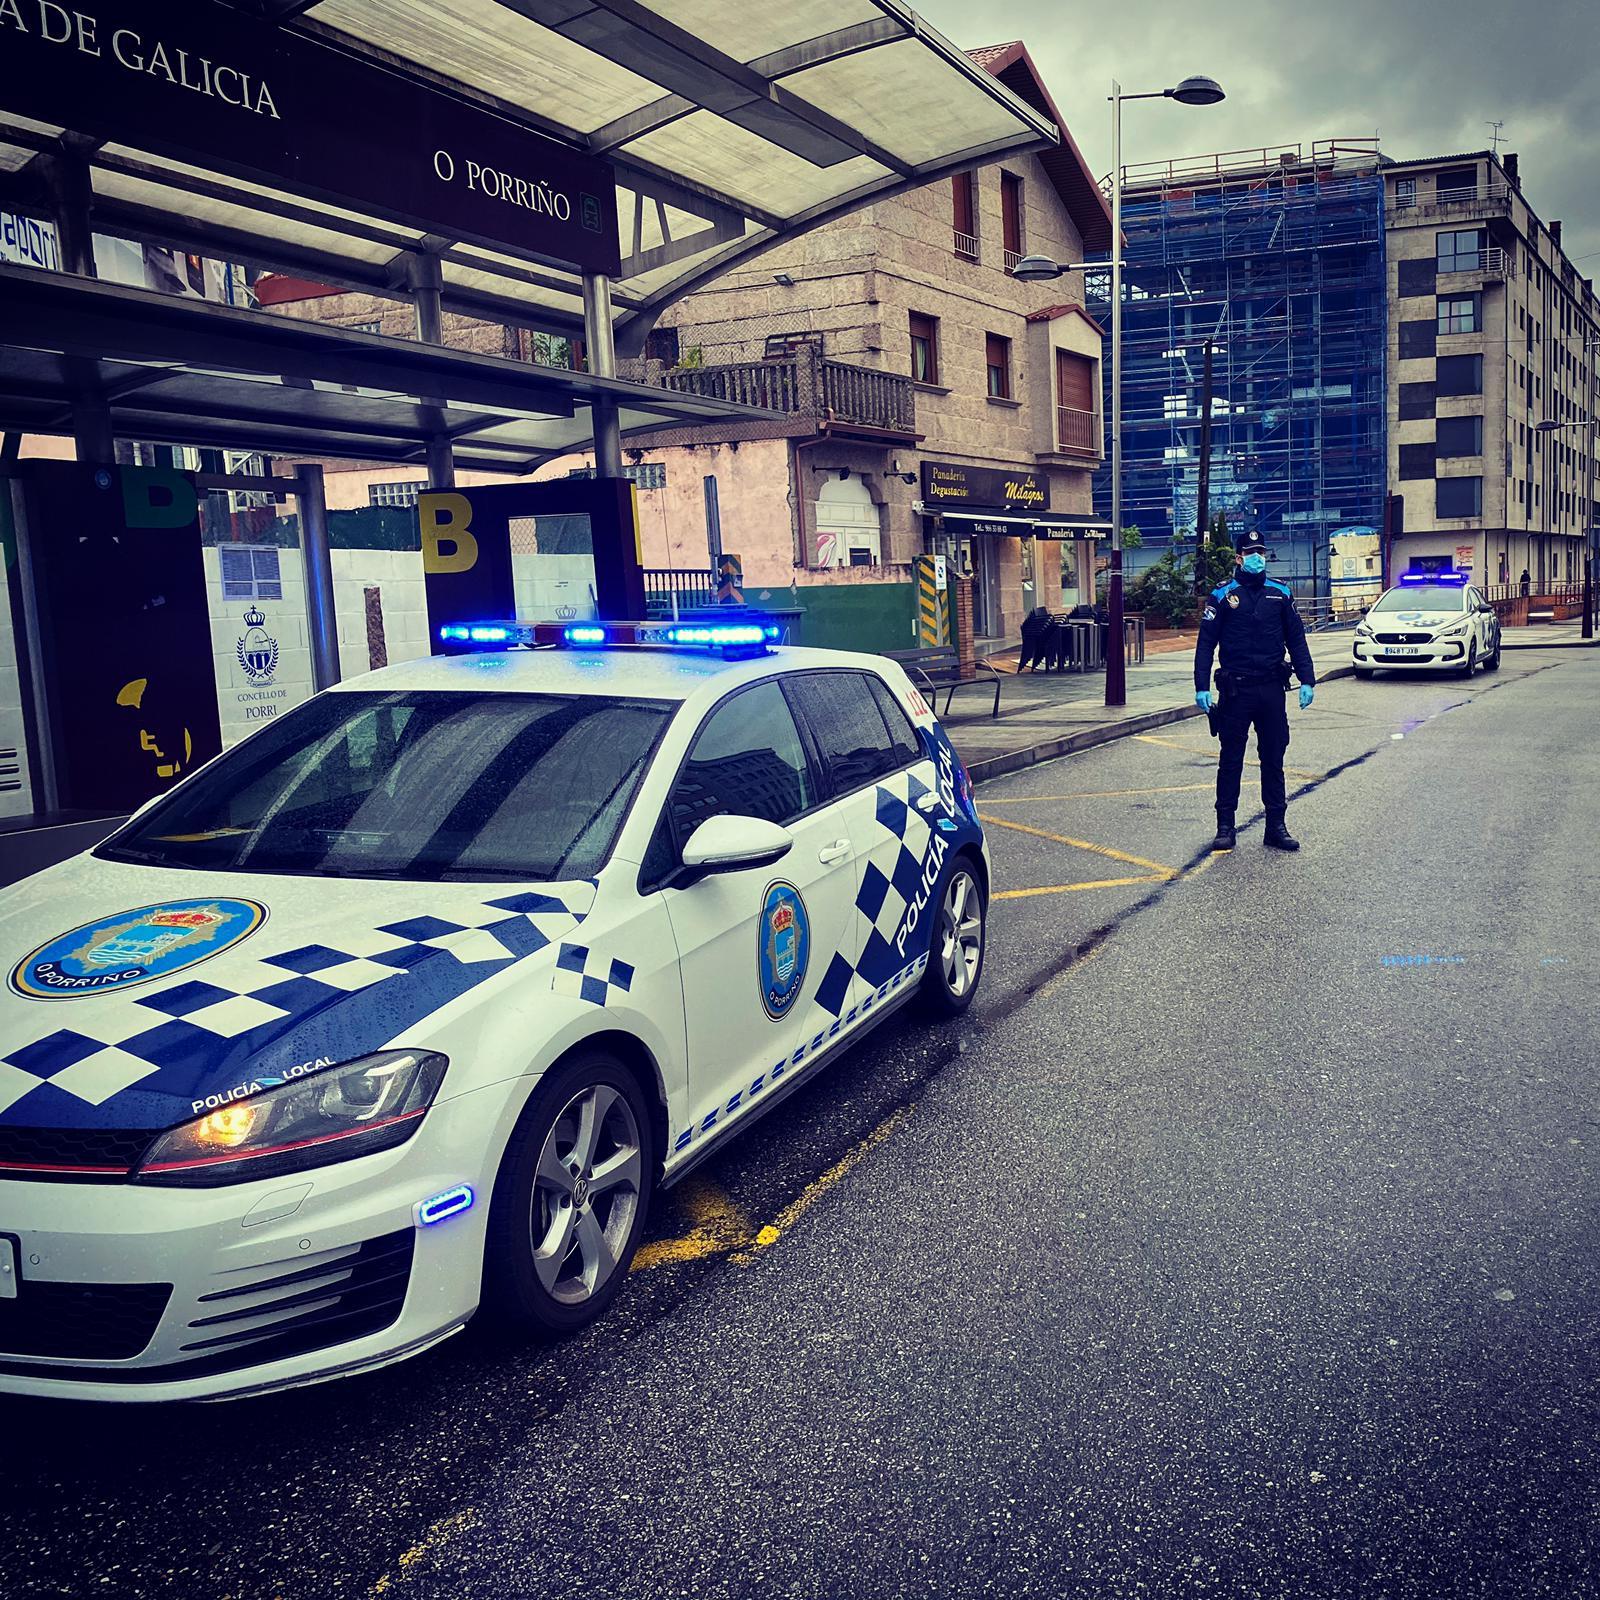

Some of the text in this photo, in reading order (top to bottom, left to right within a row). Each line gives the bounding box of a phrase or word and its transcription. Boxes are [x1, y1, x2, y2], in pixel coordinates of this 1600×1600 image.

[38, 0, 101, 57] DE
[112, 29, 281, 120] GALICIA
[434, 150, 570, 221] O PORRIÑO
[418, 492, 479, 574] B
[237, 689, 288, 702] CONCELLO DE
[246, 704, 278, 719] PORRI
[938, 740, 956, 818] LOCAL
[38, 970, 141, 988] PORRIÑO
[191, 1056, 337, 1115] POLICÍA LOCAL
